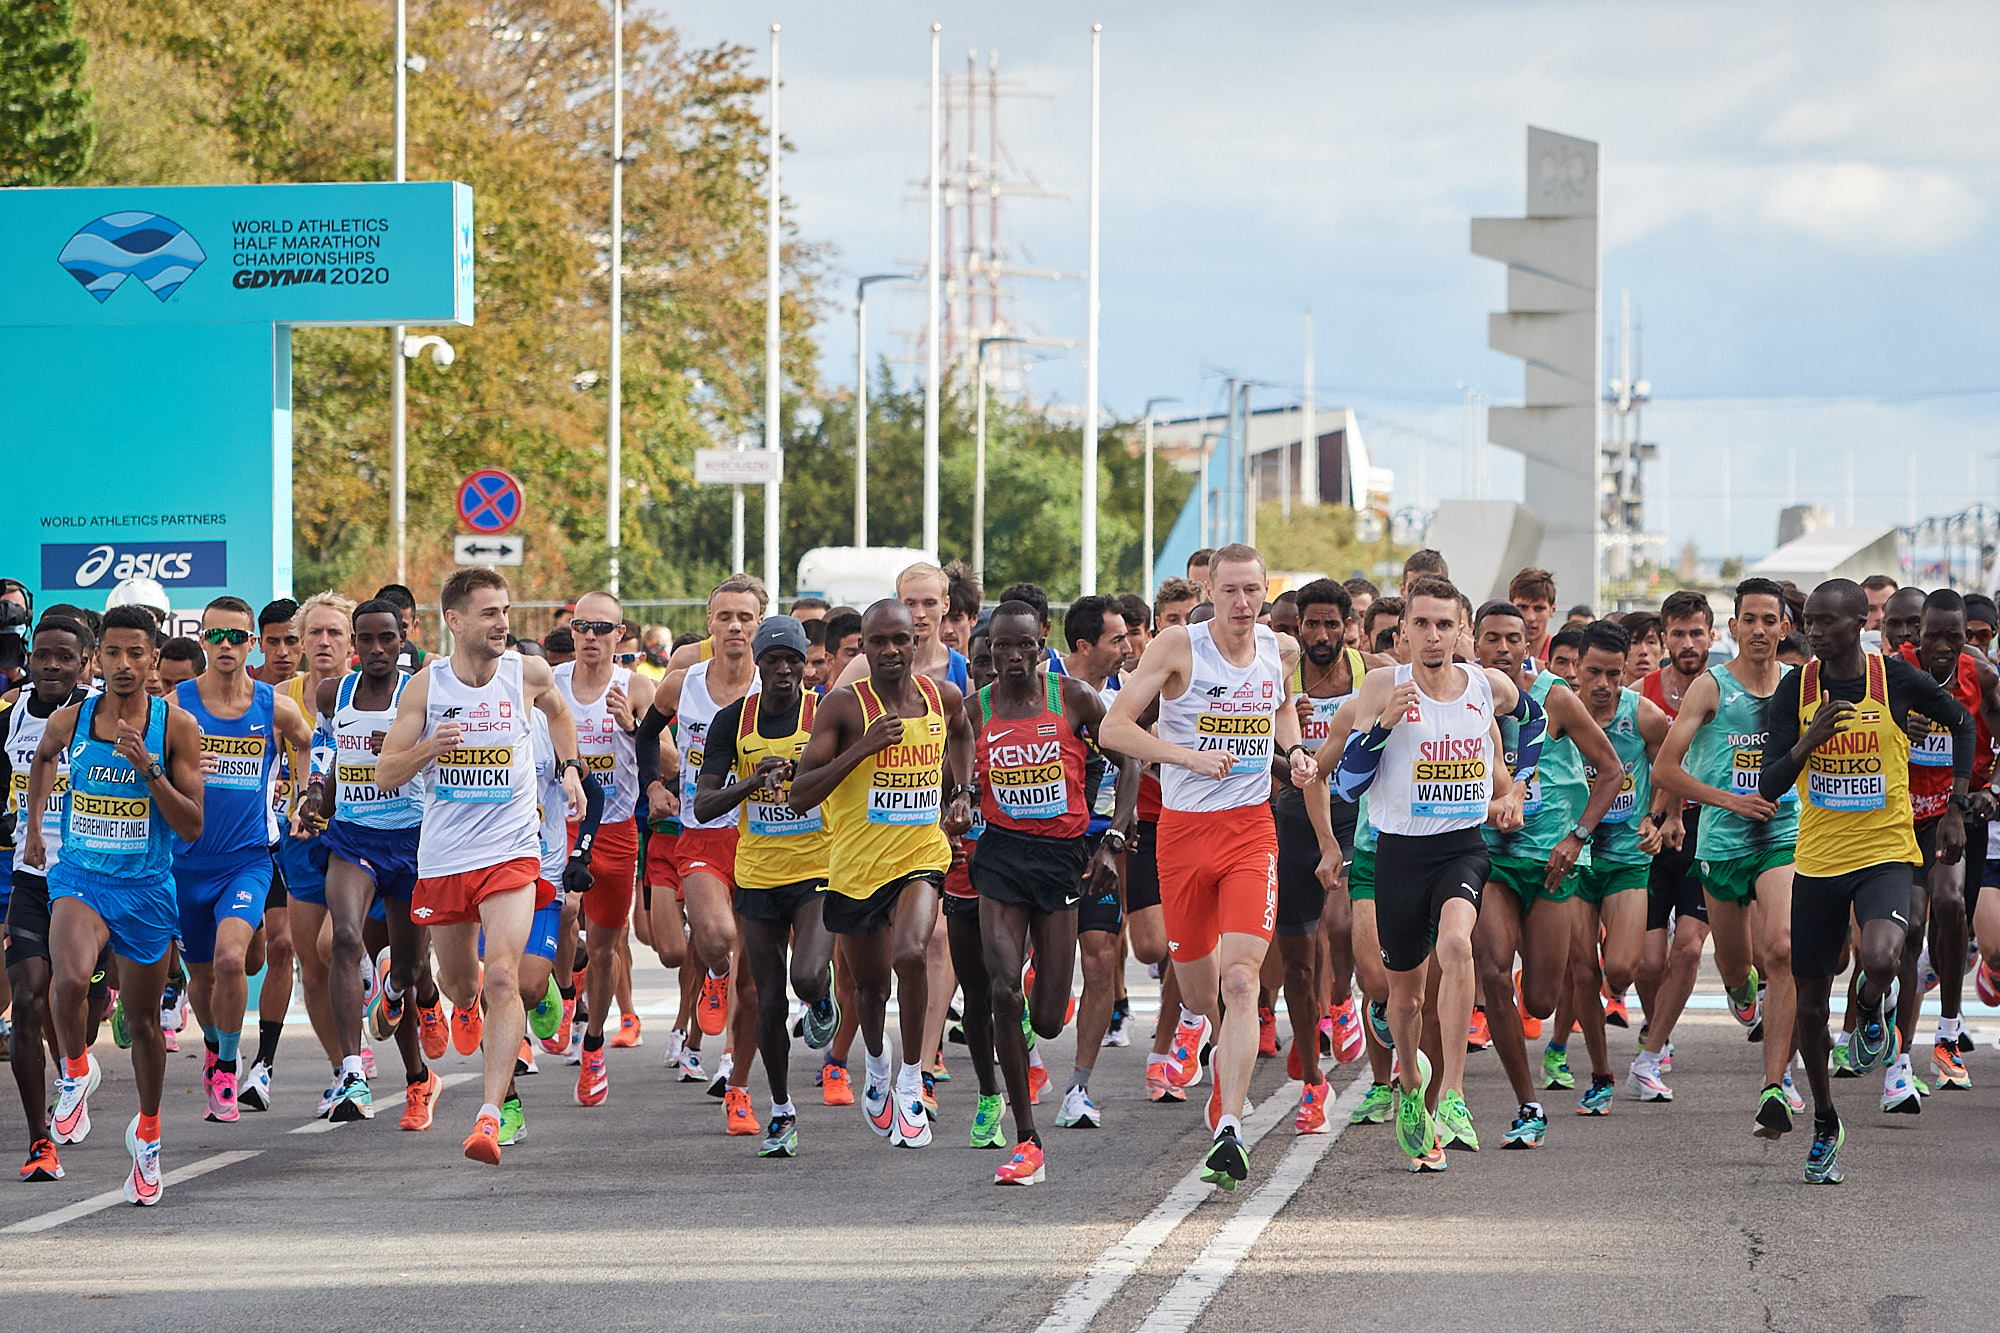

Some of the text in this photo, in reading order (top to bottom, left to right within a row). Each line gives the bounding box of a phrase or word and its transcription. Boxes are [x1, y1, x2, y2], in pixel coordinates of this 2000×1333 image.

[232, 218, 389, 234] WORLD ATHLETICS
[233, 235, 380, 250] HALF MARATHON
[233, 252, 375, 266] CHAMPIONSHIPS
[232, 267, 389, 289] GDYNIA 2020
[40, 514, 227, 527] WORLD ATHLETICS PARTNERS
[1207, 686, 1228, 698] 4F
[442, 707, 463, 719] 4F
[1209, 701, 1271, 713] POLSKA
[460, 722, 511, 732] OLSKA
[688, 722, 707, 733] 4F
[1199, 716, 1271, 734] SEIKO
[200, 737, 262, 755] SEIKO
[989, 740, 1060, 767] KENYA
[437, 749, 511, 764] SEIKO
[876, 743, 939, 768] UGANDA
[1416, 761, 1485, 779] SEIKO
[1809, 755, 1881, 774] SEIKO
[87, 765, 136, 784] ITALIA
[339, 766, 375, 782] SEI
[440, 768, 509, 786] NOWICKI
[873, 770, 938, 788] SEIKO
[991, 765, 1061, 785] SEIKO
[1417, 782, 1485, 801] WANDERS
[1811, 774, 1881, 795] CHEPTEGEI
[452, 790, 511, 798] GDYNIA 2020
[874, 789, 937, 809] KIPLIMO
[998, 784, 1060, 805] KANDIE
[1824, 797, 1883, 807] GDYNIA 2020
[74, 794, 146, 817] SEIKO
[352, 803, 386, 814] GDYNIA
[1011, 802, 1066, 815] GDYNIA 2020
[1433, 805, 1469, 814] GDYNIA
[888, 813, 924, 822] GDYNIA
[72, 814, 147, 838] GHEBREHIWET FANIEL
[765, 821, 820, 833] GDYNIA 2020
[85, 839, 145, 850] GDYNIA 2020
[1262, 852, 1276, 932] POLSKA
